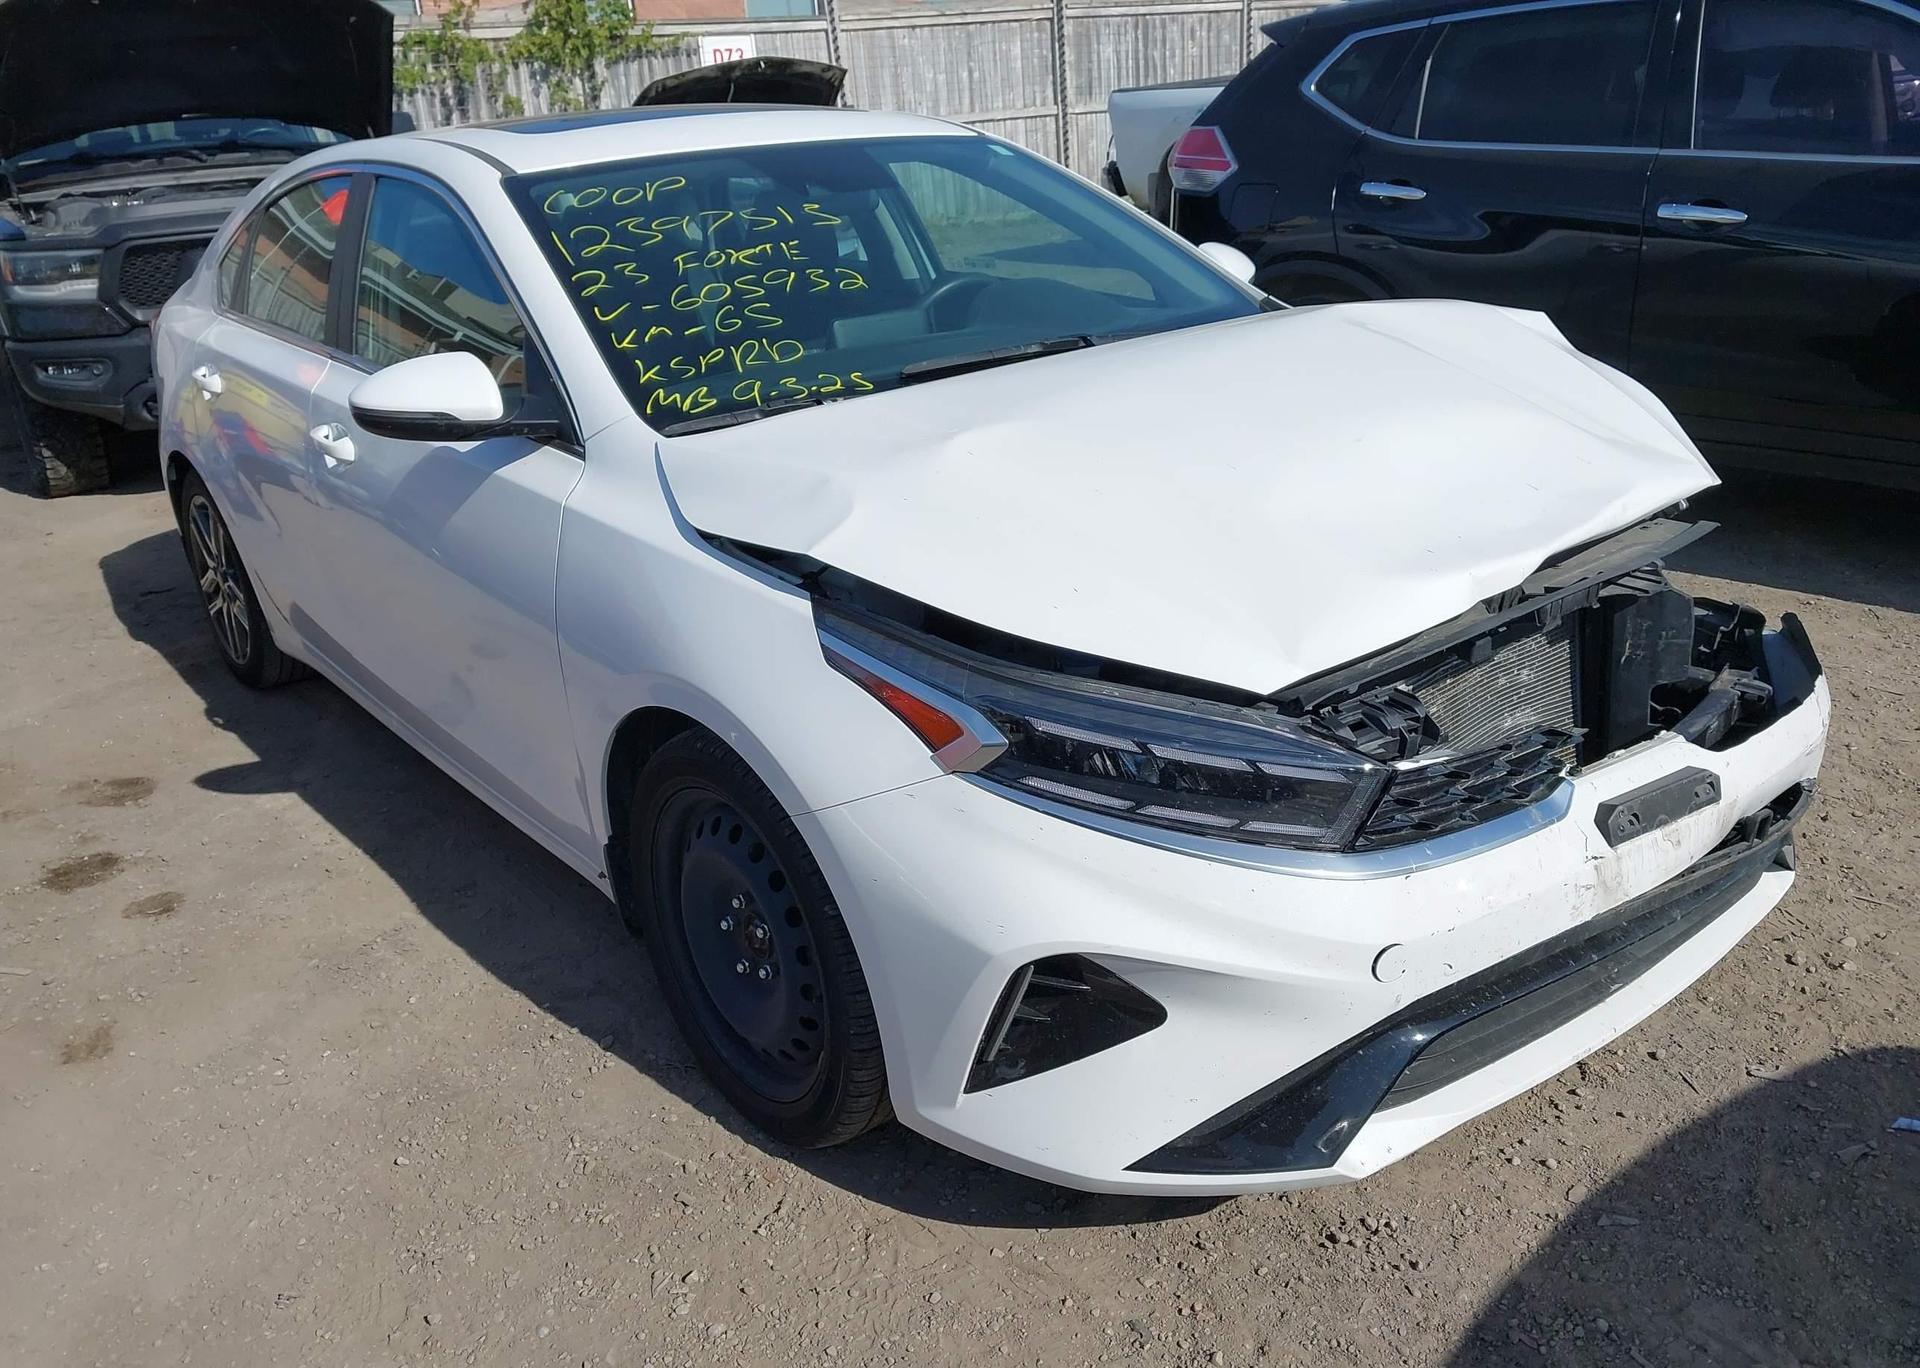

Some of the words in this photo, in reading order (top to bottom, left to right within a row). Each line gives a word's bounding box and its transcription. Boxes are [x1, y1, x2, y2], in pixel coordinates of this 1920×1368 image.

[543, 176, 686, 215] COOP
[572, 263, 650, 297] 23
[673, 240, 809, 276] FORTE
[646, 387, 717, 415] MB
